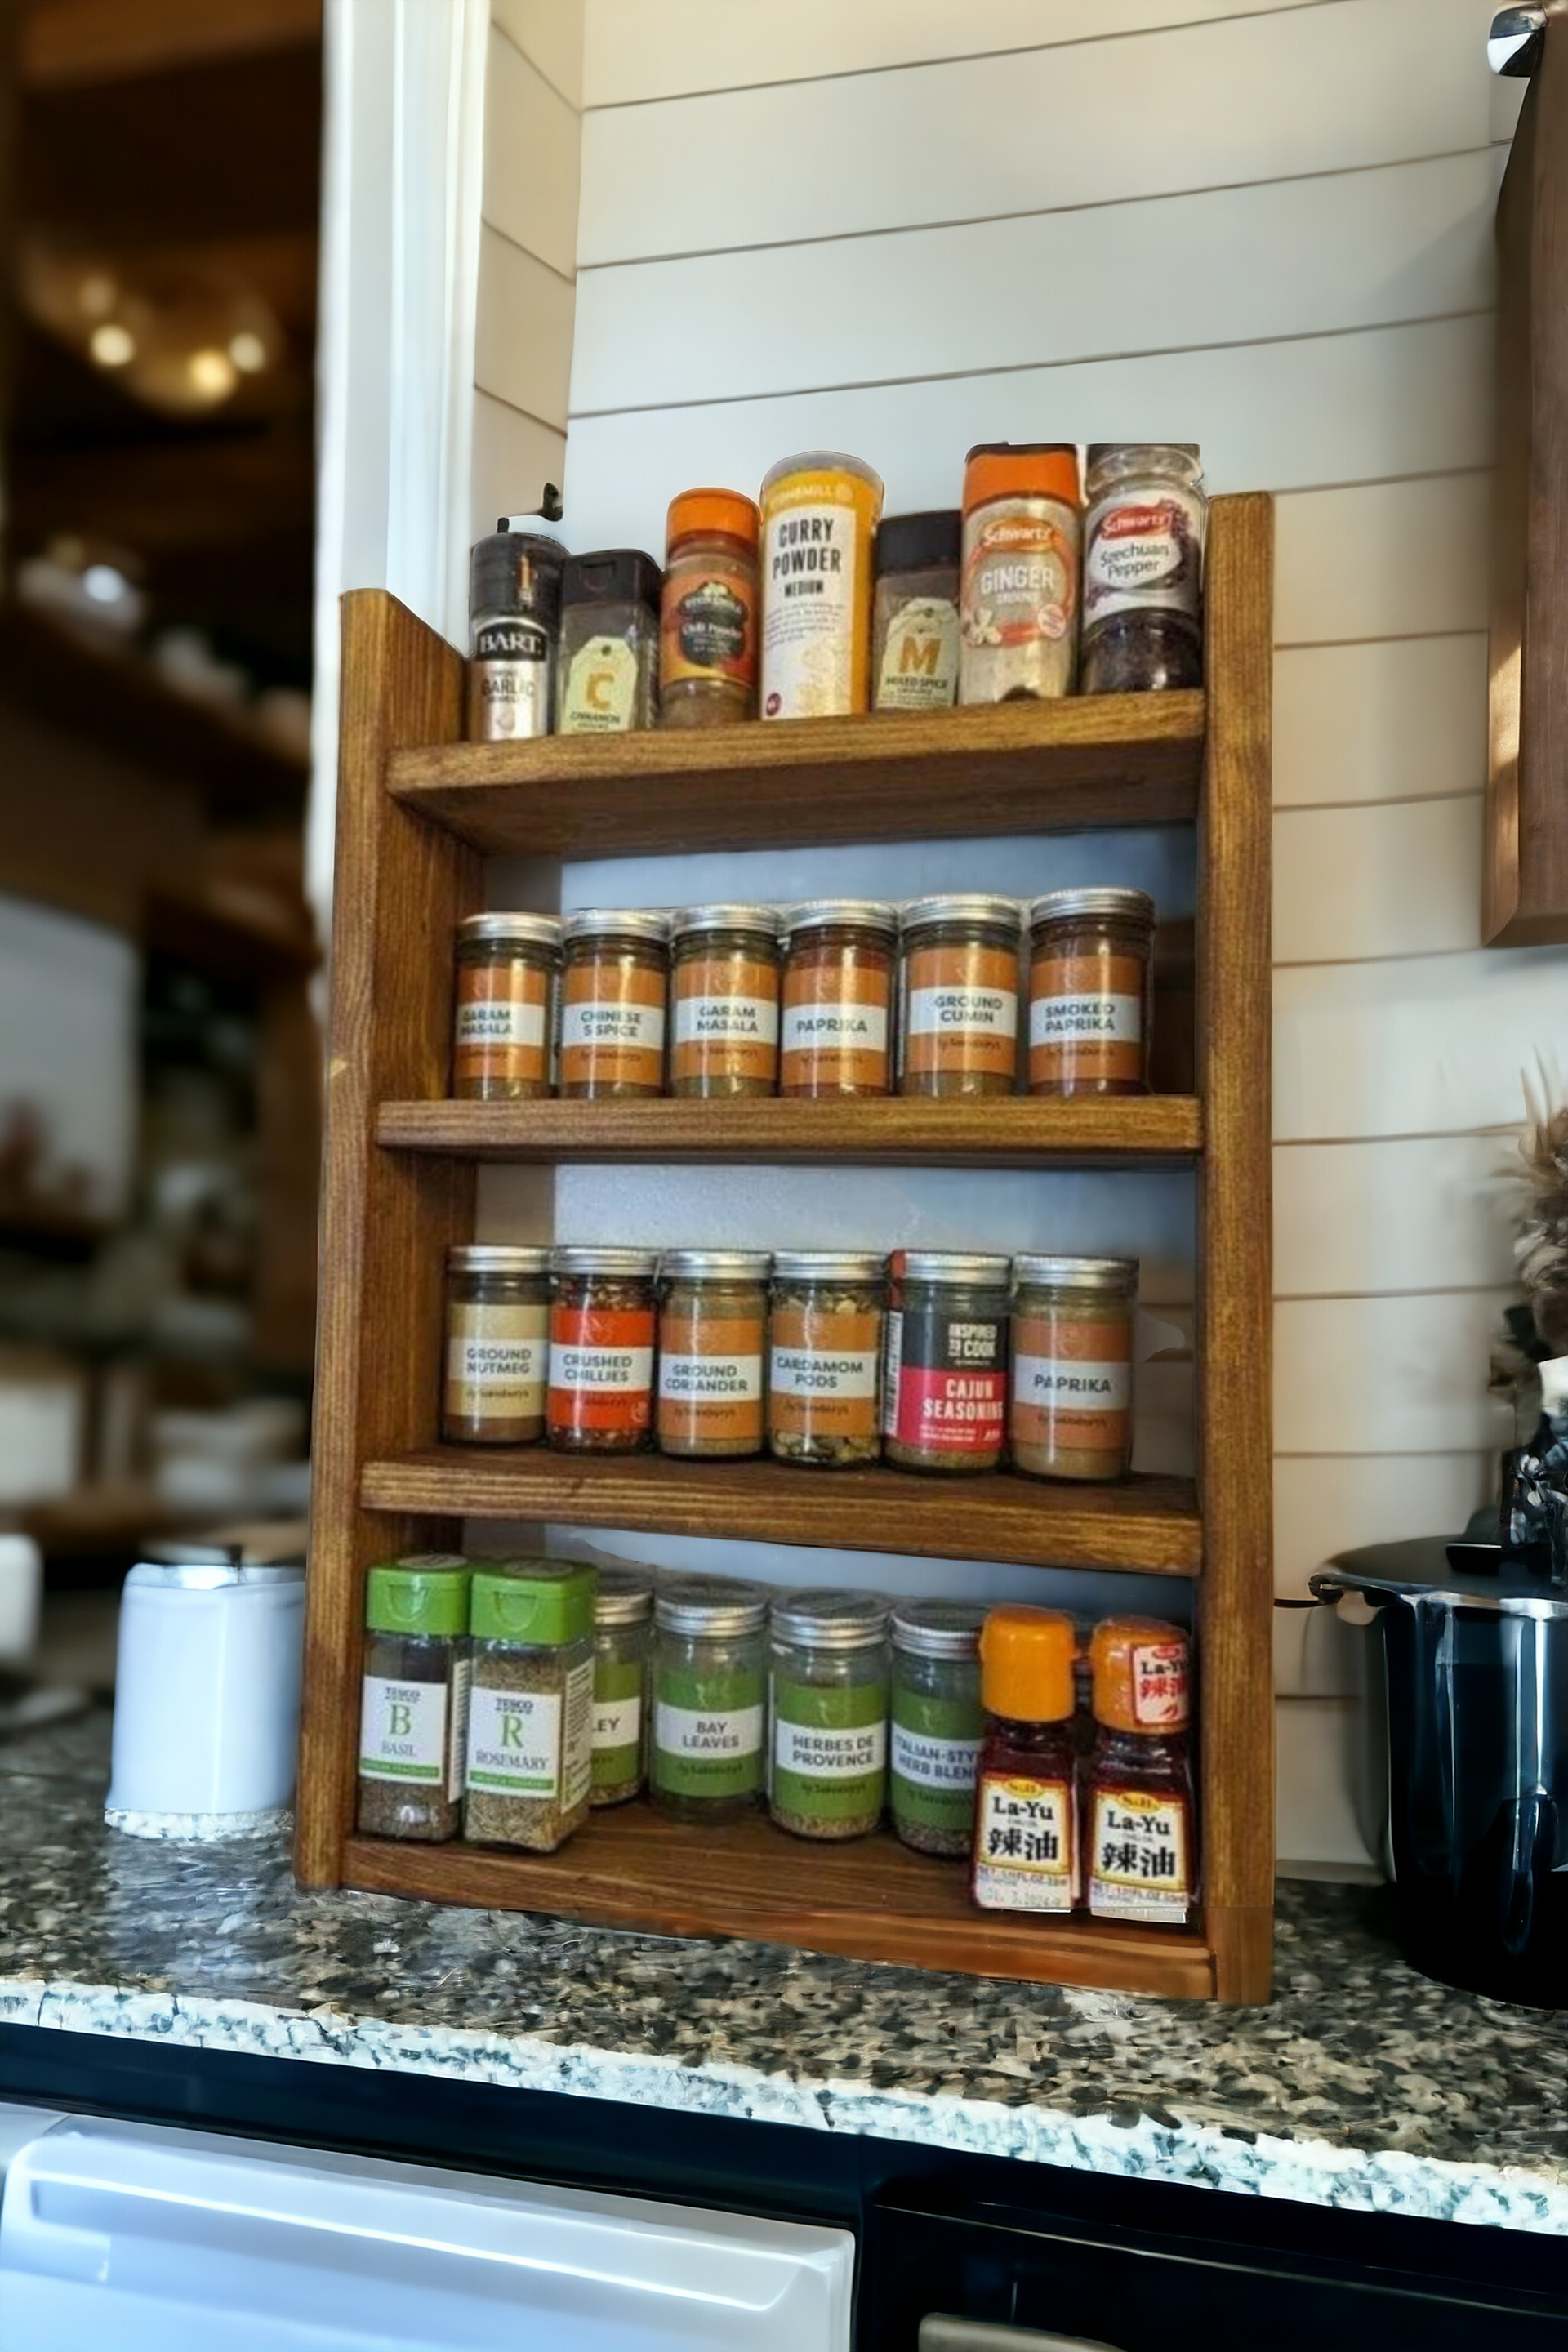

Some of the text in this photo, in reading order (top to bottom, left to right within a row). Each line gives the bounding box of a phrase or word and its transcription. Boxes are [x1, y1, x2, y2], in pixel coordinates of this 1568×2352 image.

[778, 517, 834, 548] CURRY
[773, 547, 841, 580] POWDER
[1101, 542, 1169, 568] Szechuan
[1107, 560, 1160, 579] Pepper
[981, 565, 1054, 595] GINGER
[784, 581, 824, 598] MEDIUM
[480, 631, 541, 653] BART
[898, 636, 942, 675] M
[586, 671, 614, 710] C
[934, 995, 1003, 1010] GROUND
[1045, 1002, 1115, 1018] SMOKED
[699, 1005, 755, 1018] GARAM
[940, 1010, 993, 1022] CUMIN
[595, 1024, 639, 1037] SPICE
[697, 1019, 758, 1032] MASALA
[796, 1018, 867, 1033] PAPRIKA
[1045, 1018, 1116, 1032] PAPRIKA
[466, 1348, 532, 1361] GROUND
[964, 1340, 996, 1357] COOK
[466, 1362, 530, 1374] NUTMEG
[563, 1353, 633, 1368] CRUSHED
[777, 1356, 863, 1374] CARDAMOM
[564, 1368, 629, 1382] CHILLIES
[672, 1365, 737, 1377] GROUND
[664, 1378, 749, 1392] CORIANDER
[795, 1374, 838, 1388] PODS
[946, 1378, 993, 1400] CAJUN
[1034, 1374, 1111, 1393] PAPRIKA
[390, 1704, 411, 1735] B
[592, 1717, 621, 1732] EY
[697, 1721, 728, 1734] BAY
[501, 1714, 524, 1748] R
[381, 1741, 417, 1757] BASIL
[683, 1735, 740, 1748] LEAVES
[792, 1735, 875, 1752] HERBES DE
[475, 1750, 549, 1771] ROSEMARY
[792, 1749, 875, 1767] PROVENCE
[934, 1765, 974, 1780] BLEN
[992, 1796, 1054, 1820] La-Yu
[1107, 1809, 1170, 1836] La-Yu
[988, 1827, 1059, 1861] 辣油
[1102, 1842, 1176, 1878] 辣油
